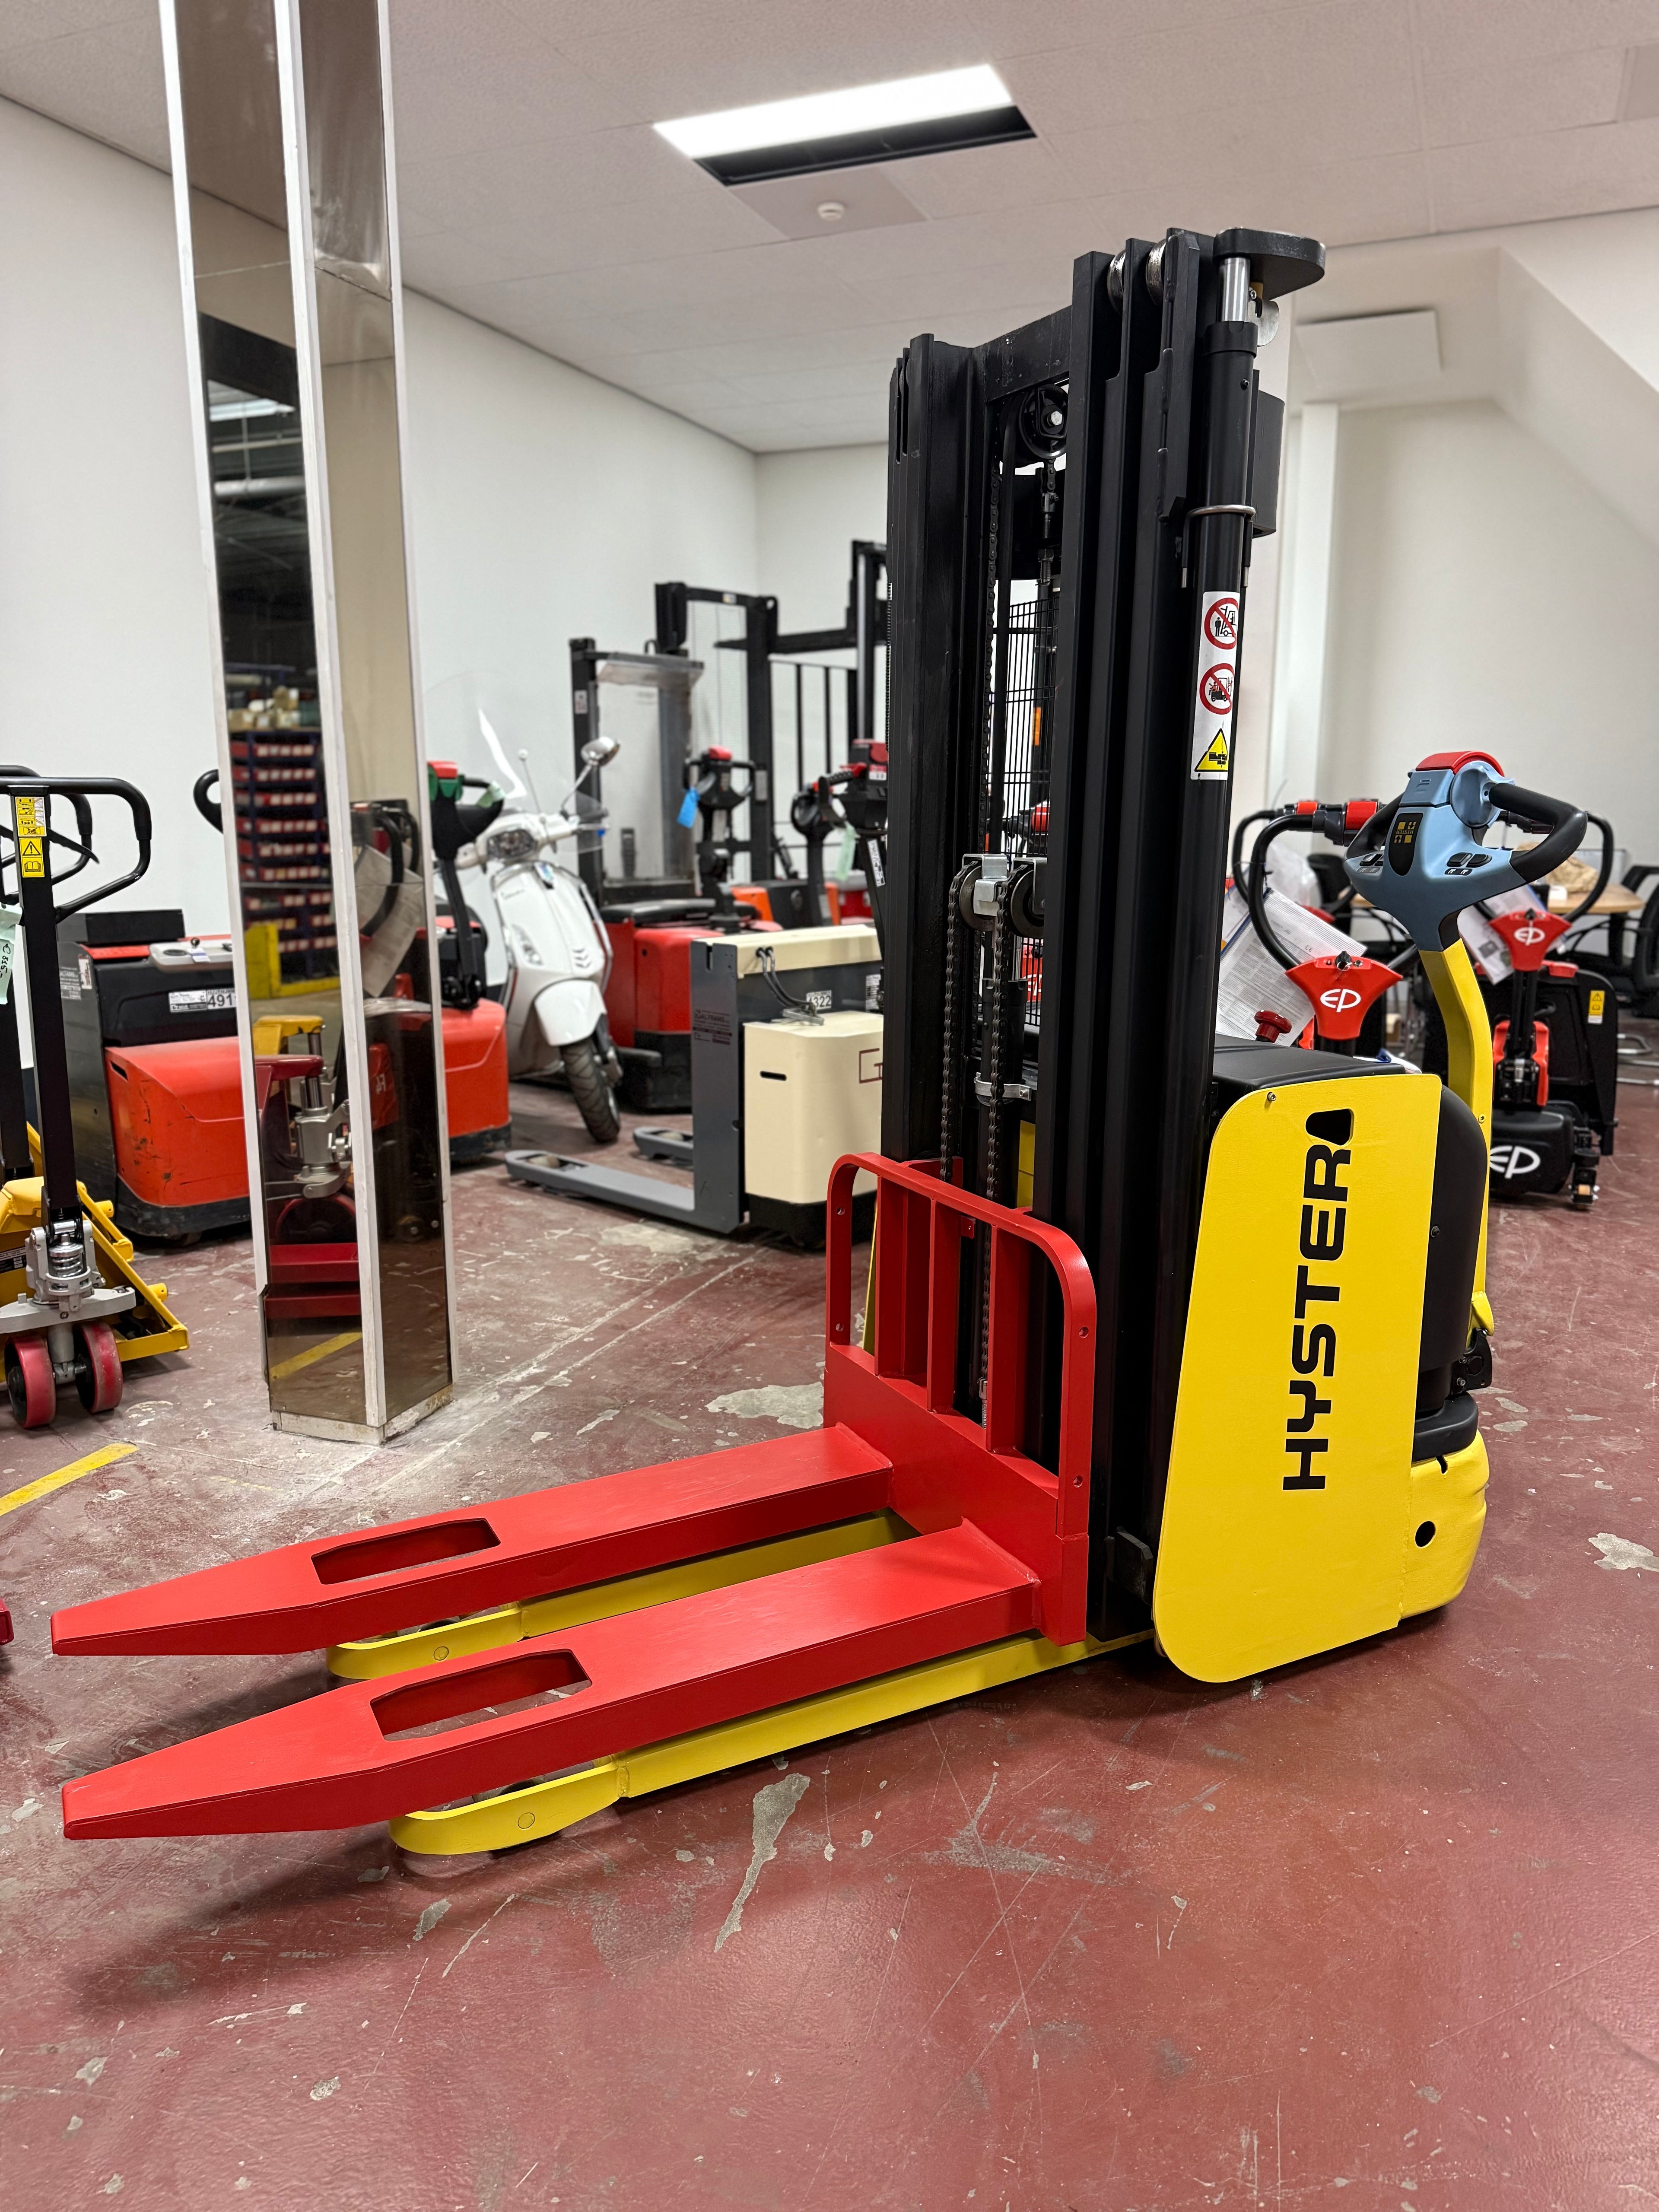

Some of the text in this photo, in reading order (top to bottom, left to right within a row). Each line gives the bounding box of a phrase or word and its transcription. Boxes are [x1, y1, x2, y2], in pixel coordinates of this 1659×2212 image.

[1514, 927, 1545, 946] EP
[207, 994, 236, 1007] 491
[1320, 988, 1361, 1013] EP
[1490, 1145, 1541, 1179] EP
[1283, 1144, 1351, 1490] HYSTER
